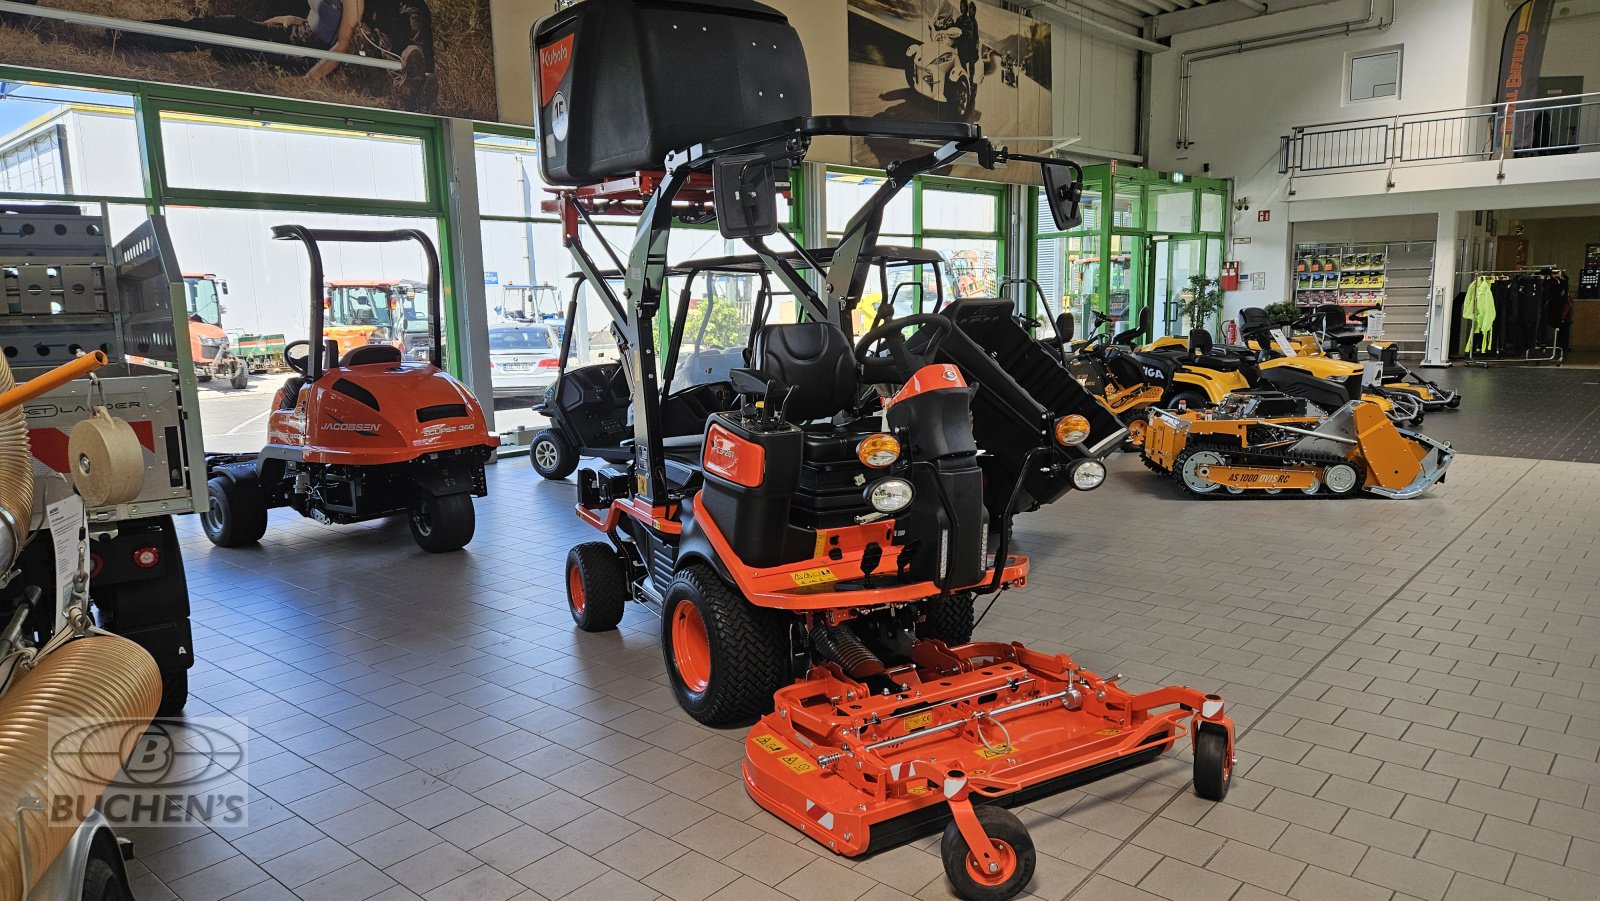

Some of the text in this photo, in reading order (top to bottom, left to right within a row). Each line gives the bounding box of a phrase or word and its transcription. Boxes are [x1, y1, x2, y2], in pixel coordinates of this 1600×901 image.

[542, 44, 568, 67] Kubota
[1506, 33, 1529, 88] ENFIELD
[60, 401, 141, 413] LADER
[320, 423, 380, 432] JACOBSEN
[1228, 474, 1290, 483] AS 1000 OVIS RC
